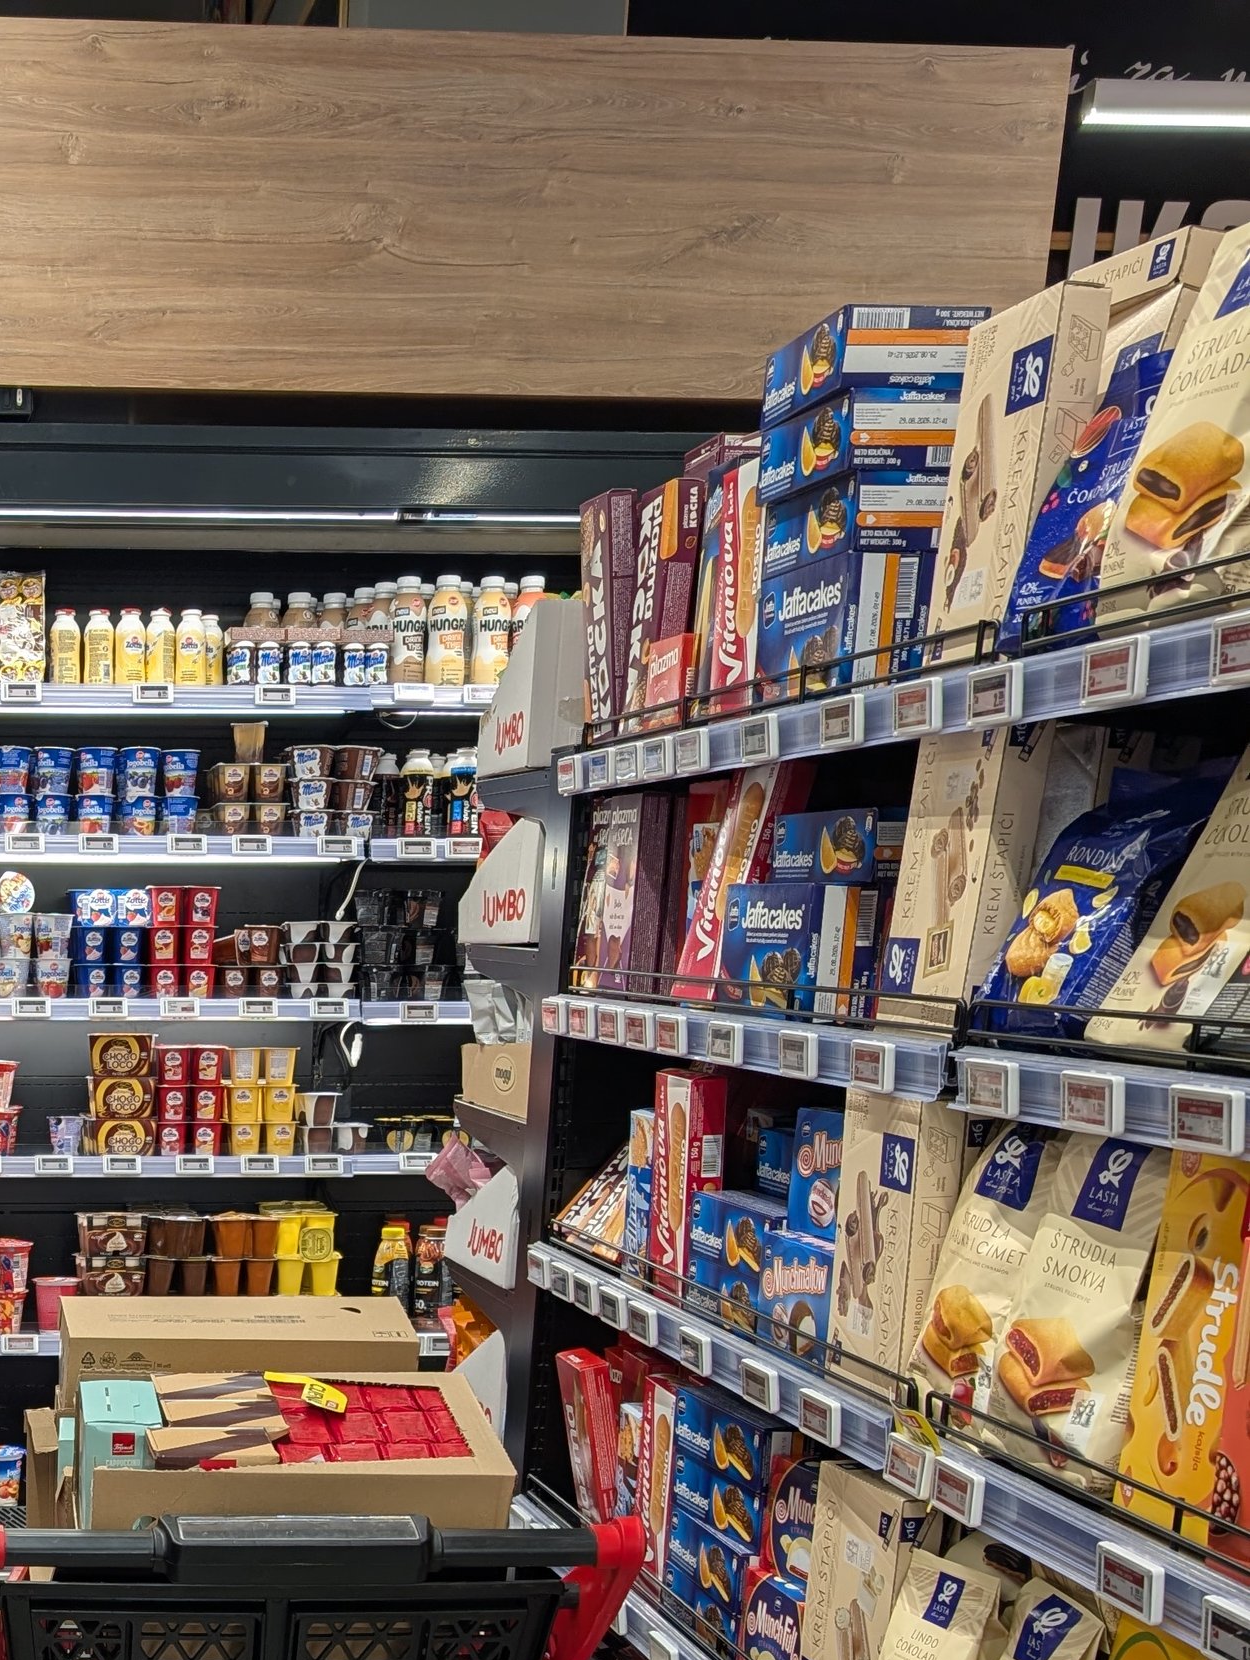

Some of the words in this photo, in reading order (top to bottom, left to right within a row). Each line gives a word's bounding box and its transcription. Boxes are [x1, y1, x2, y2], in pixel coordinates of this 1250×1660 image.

[1006, 430, 1027, 509] KREM
[689, 486, 699, 528] KOCKA
[726, 482, 734, 515] keks
[644, 495, 662, 619] plazma
[751, 523, 761, 596] POSNO
[719, 521, 743, 687] Vitanova
[441, 634, 463, 644] DRINK
[650, 647, 679, 683] plazma
[493, 711, 525, 756] JUMBO
[901, 851, 918, 919] KREM
[982, 879, 1002, 936] KREM
[995, 811, 1015, 873] ŠTAPIĆI
[482, 888, 526, 928] JUMBO
[40, 970, 68, 978] Jogobella
[901, 947, 913, 984] LASTA
[107, 1061, 134, 1069] LOCO
[494, 1067, 512, 1083] mogyi
[110, 1103, 136, 1111] LOCO
[111, 1145, 139, 1153] LOCO
[886, 1142, 894, 1179] LASTA
[654, 1116, 673, 1267] Vitanova
[986, 1166, 1021, 1189] LASTA
[1088, 1186, 1121, 1207] LASTA
[468, 1218, 504, 1264] JUMBO
[883, 1208, 900, 1274] KREM
[976, 1239, 1026, 1267] CIMET
[1049, 1234, 1118, 1270] ŠTRUDLA
[1042, 1255, 1108, 1294] SMOKVA
[812, 1588, 828, 1650] KREM
[932, 1604, 950, 1619] LASTA
